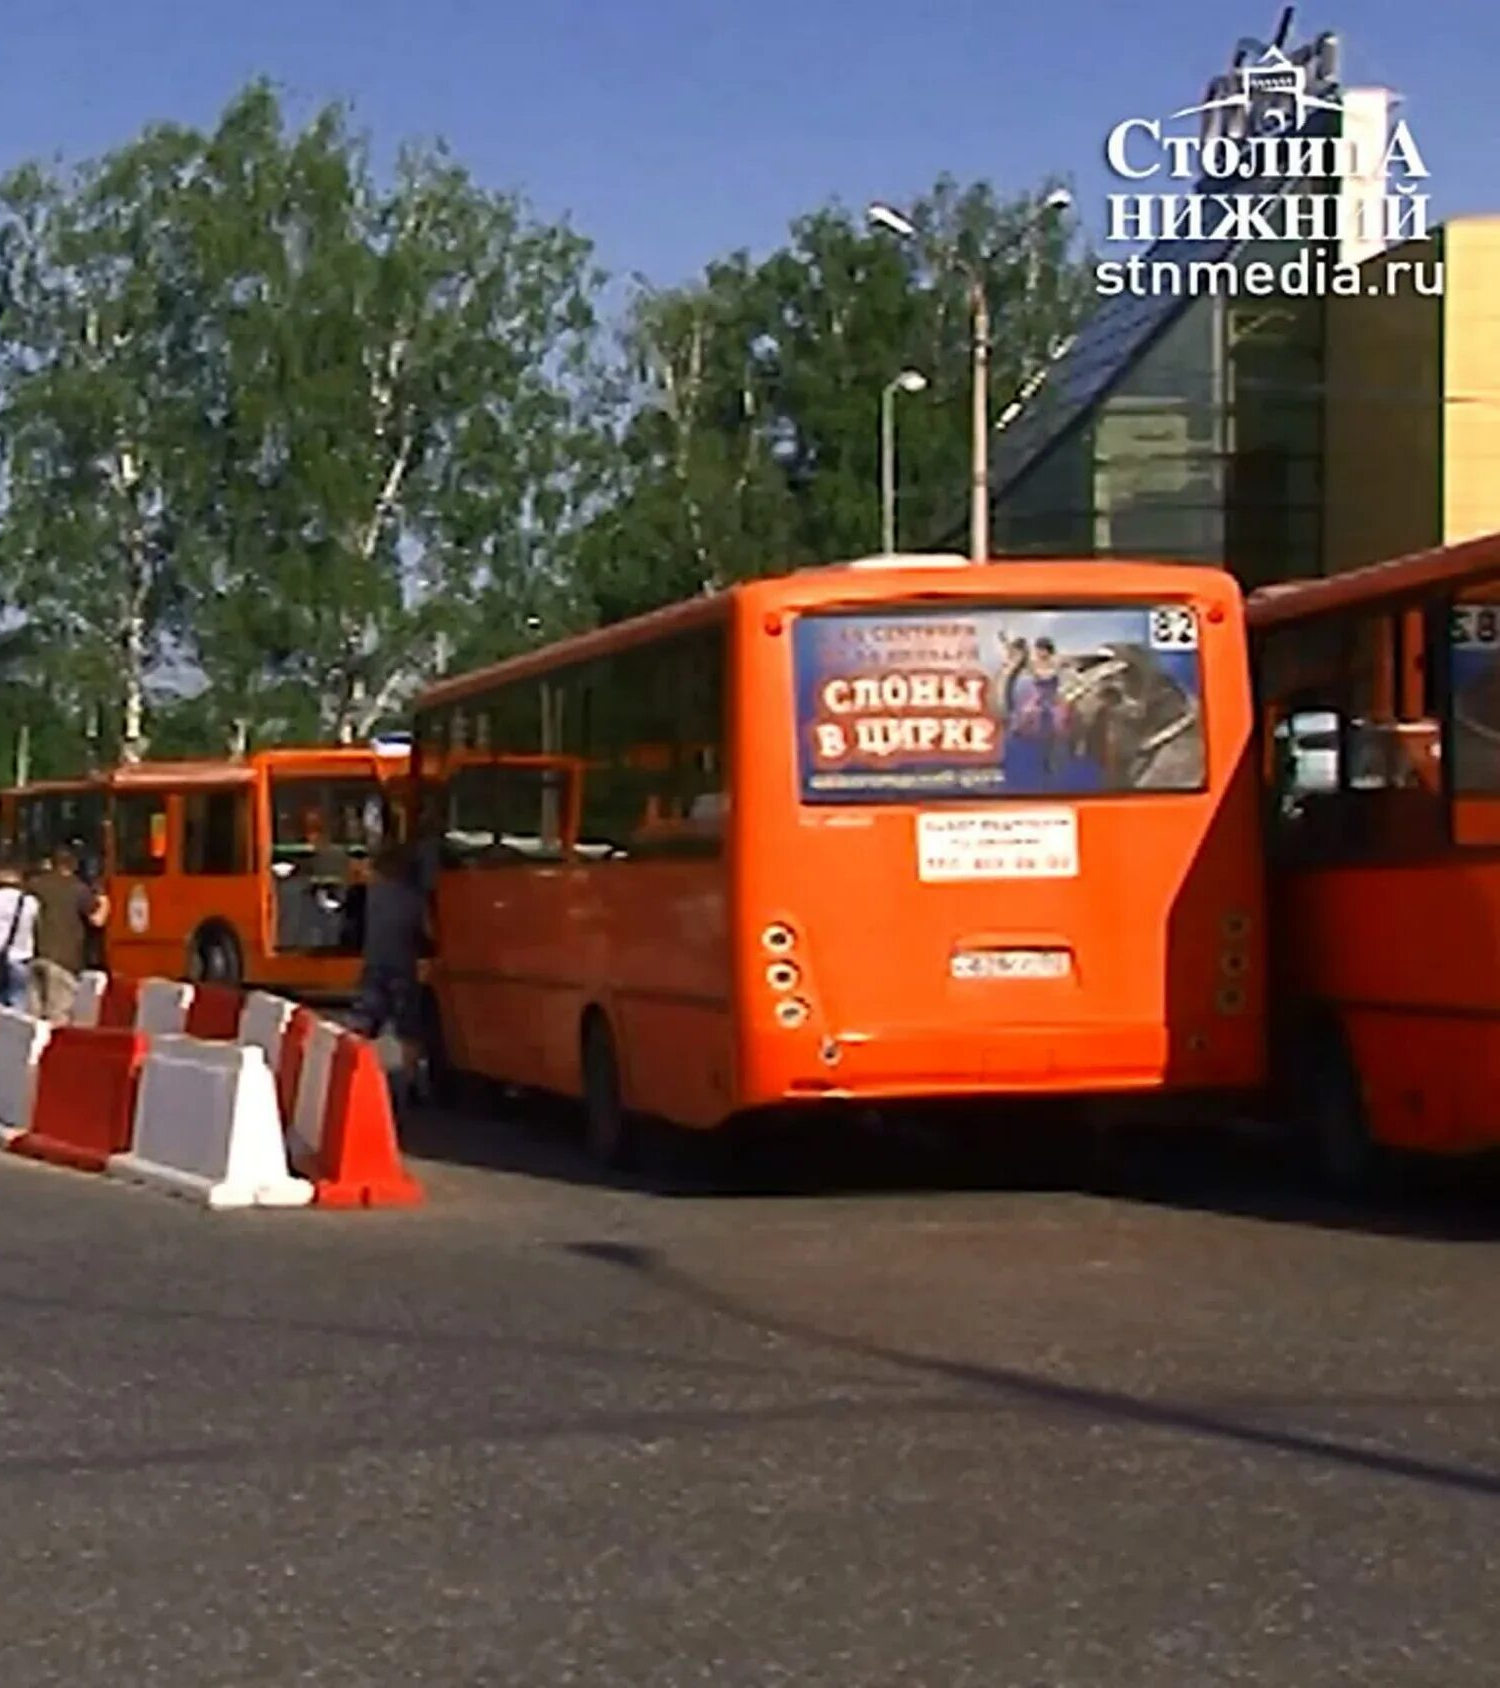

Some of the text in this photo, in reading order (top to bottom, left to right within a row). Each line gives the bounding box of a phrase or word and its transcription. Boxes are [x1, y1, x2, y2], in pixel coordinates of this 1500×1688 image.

[1153, 611, 1192, 643] 82
[823, 673, 984, 714] СЛОНЫ
[815, 716, 996, 758] В ЦИРКЕ
